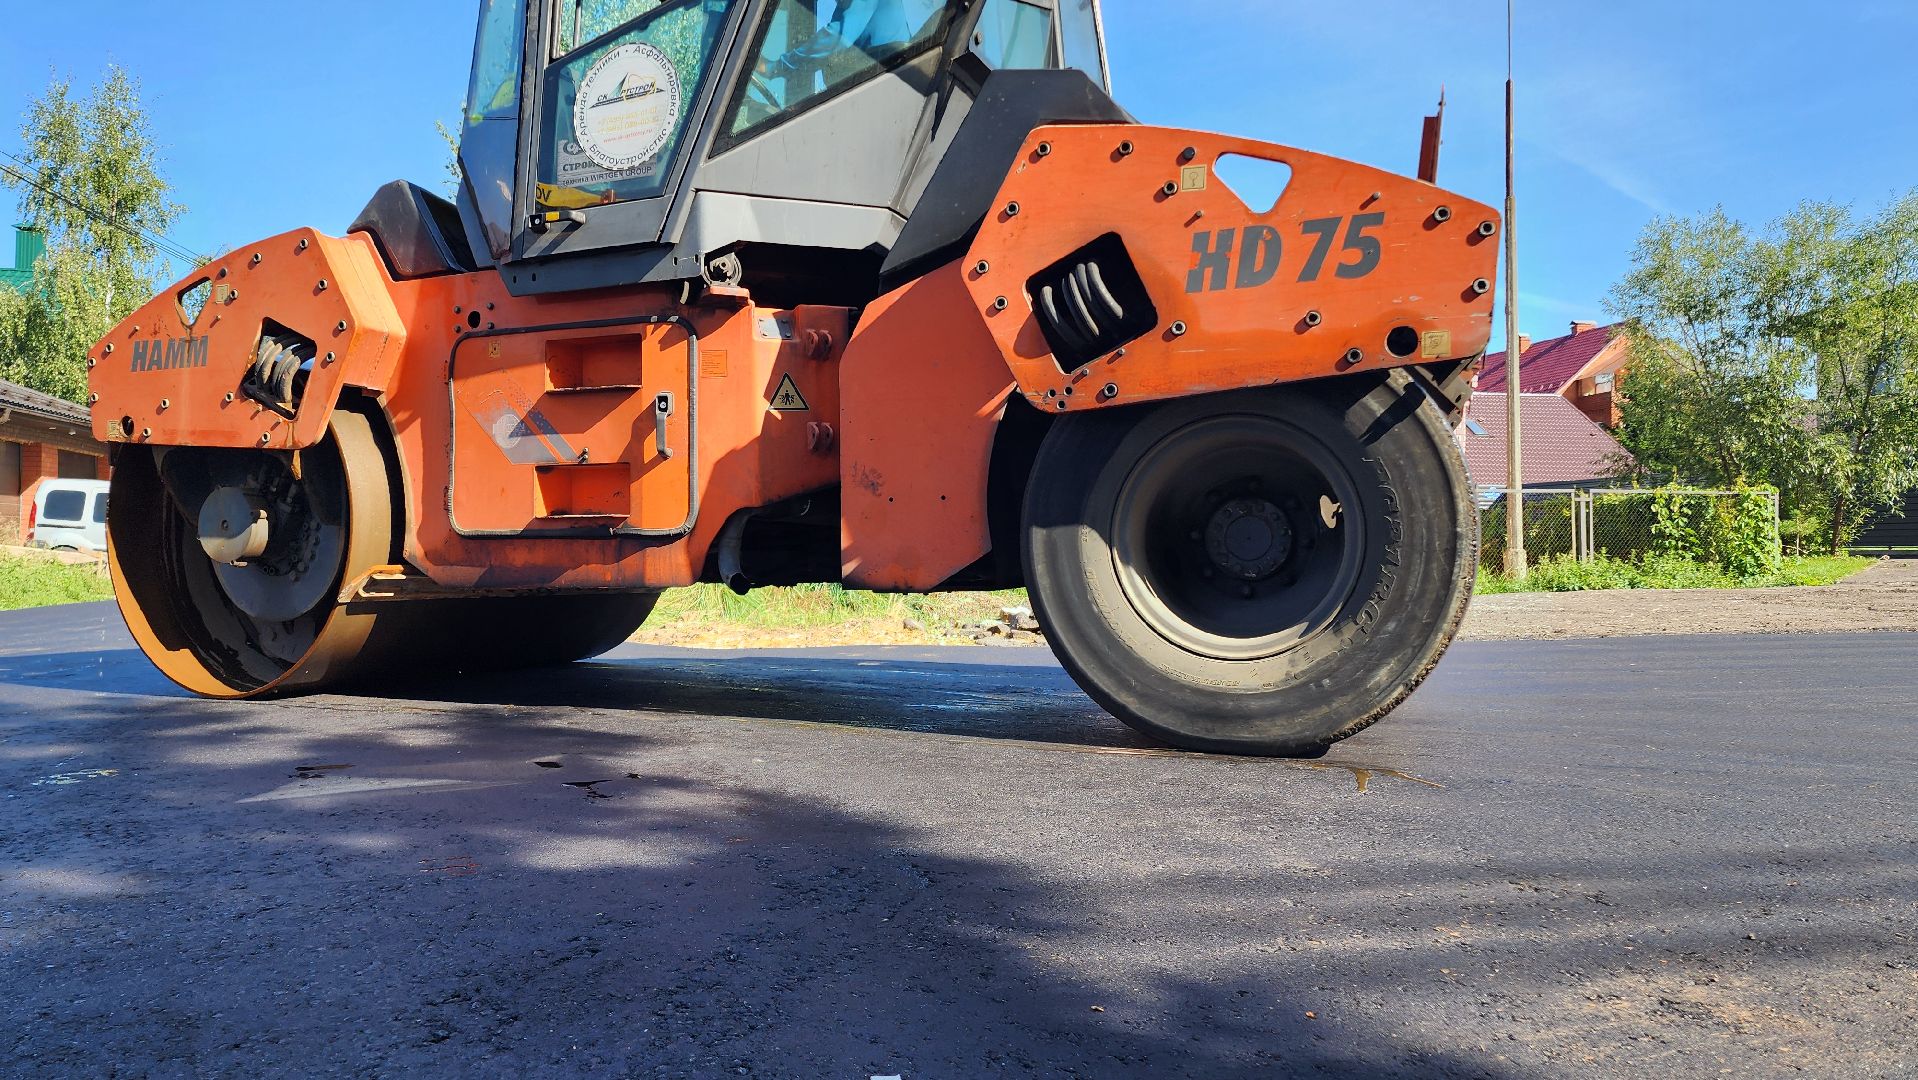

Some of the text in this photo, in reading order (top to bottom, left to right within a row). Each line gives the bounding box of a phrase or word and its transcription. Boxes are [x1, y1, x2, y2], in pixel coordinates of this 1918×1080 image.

[579, 51, 620, 136] Аренда техники
[633, 46, 677, 116] Асфальтировка
[589, 128, 667, 166] Благоустройство
[590, 170, 624, 182] WIRTGEN
[625, 166, 652, 177] GROUP
[1184, 211, 1385, 294] HD 75
[131, 336, 208, 372] HAMM
